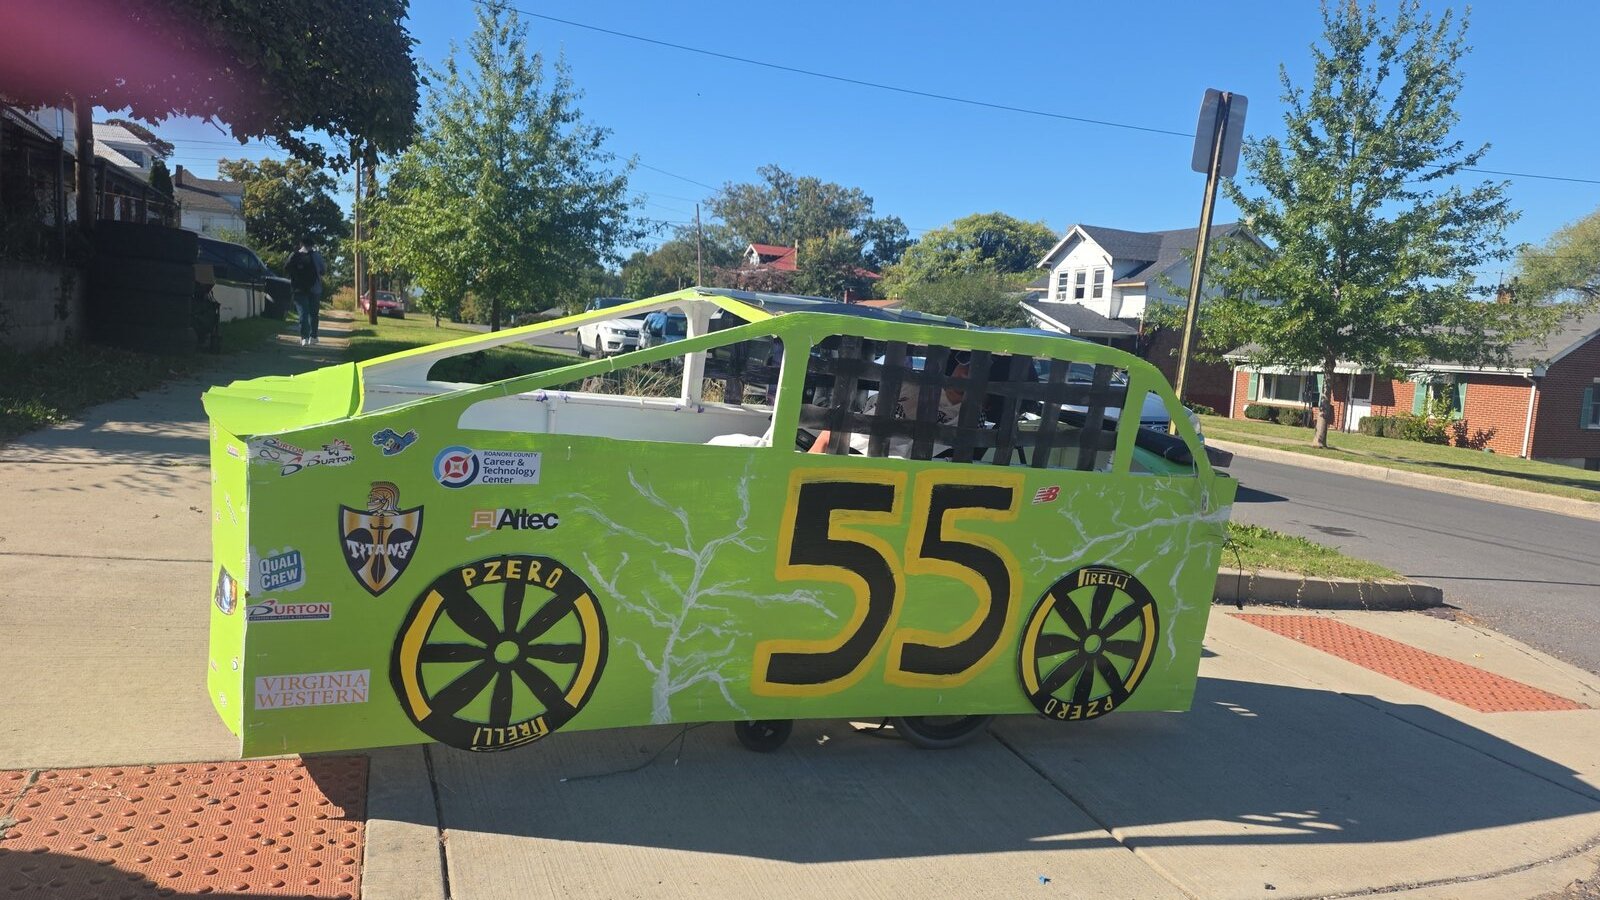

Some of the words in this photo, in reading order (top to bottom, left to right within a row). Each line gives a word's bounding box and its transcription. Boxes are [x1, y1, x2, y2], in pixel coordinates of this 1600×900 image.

[482, 466, 536, 477] Technology
[483, 458, 515, 466] Career
[517, 458, 525, 466] &
[482, 475, 514, 484] Center
[496, 508, 559, 530] Altec
[346, 539, 414, 561] TITANS
[259, 553, 298, 574] QUALI
[260, 568, 299, 588] CREW
[752, 467, 1025, 697] 55
[1077, 569, 1132, 589] PIRELLI
[247, 600, 330, 616] BURTON
[263, 673, 368, 691] VIRGINIA
[257, 688, 367, 708] WESTERN
[471, 716, 550, 752] PIRELLI
